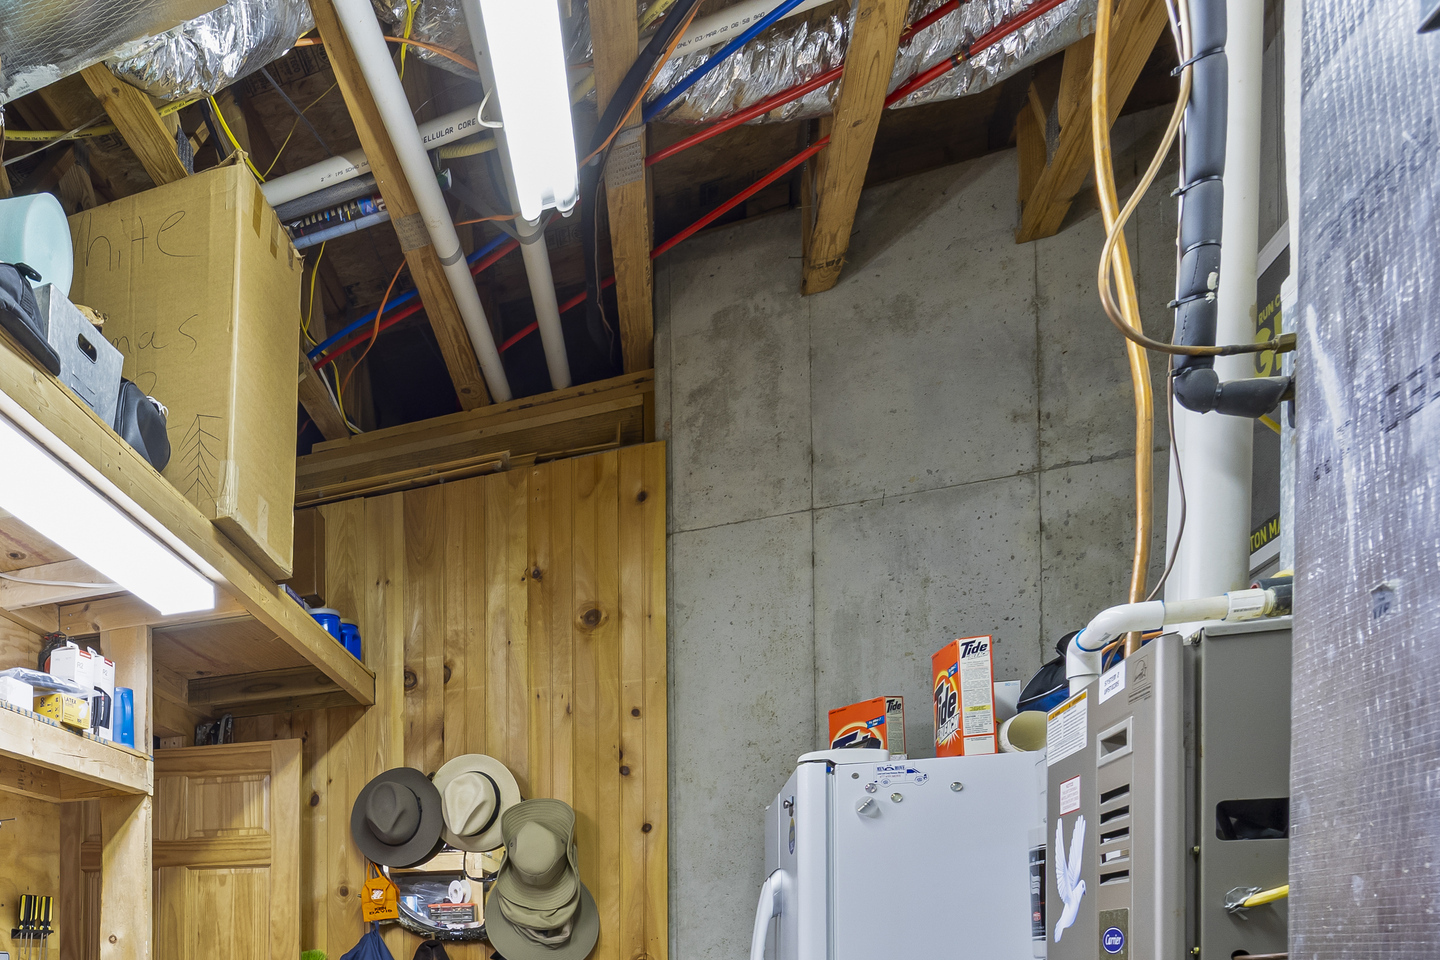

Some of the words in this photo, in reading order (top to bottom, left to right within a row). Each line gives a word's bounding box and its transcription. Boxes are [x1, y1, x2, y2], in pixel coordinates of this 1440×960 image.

[677, 39, 692, 49] ONLY
[421, 126, 454, 144] ELLULAR
[457, 117, 476, 131] CORE
[1258, 300, 1274, 326] RUN
[961, 639, 988, 659] Tide
[64, 696, 77, 704] LATEX
[886, 698, 902, 714] Tide
[935, 679, 957, 730] Tide
[1105, 934, 1122, 946] Carrier
